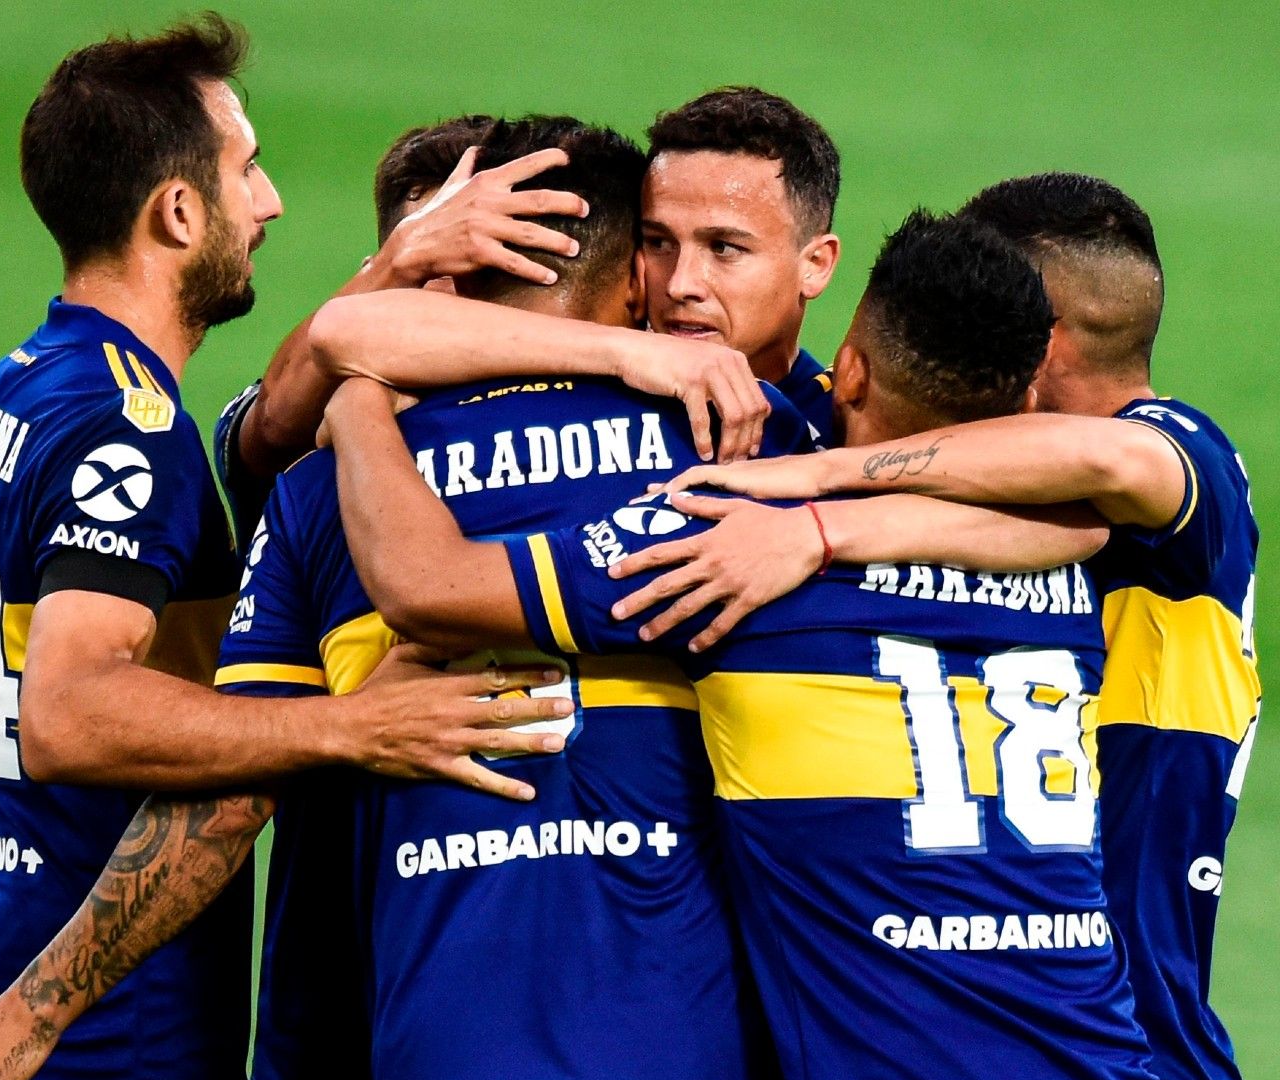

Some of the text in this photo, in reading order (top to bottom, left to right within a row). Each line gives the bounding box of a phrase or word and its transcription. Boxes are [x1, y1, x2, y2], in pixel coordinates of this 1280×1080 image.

[416, 412, 673, 499] ARADONA
[48, 523, 140, 560] AXION
[875, 635, 1098, 850] 18
[871, 910, 1113, 951] GARBARINO
